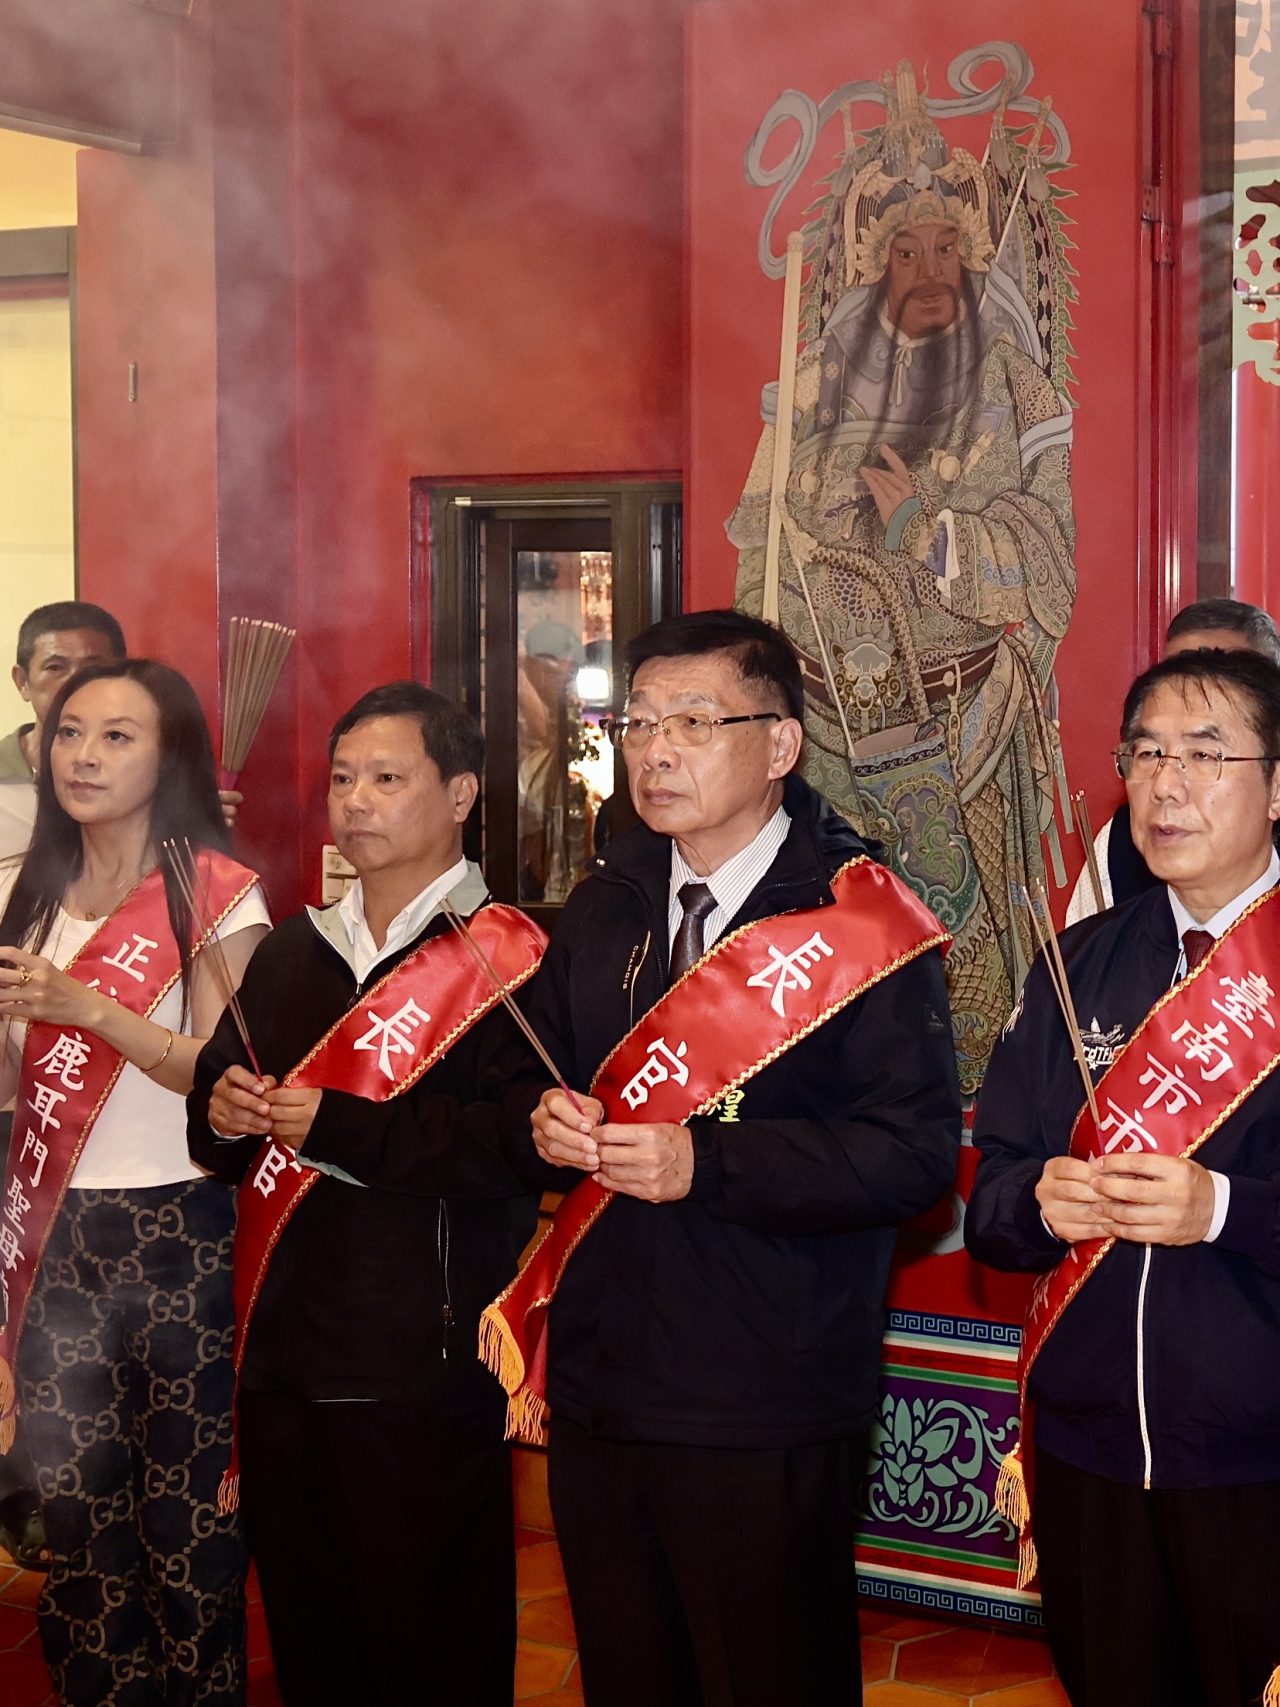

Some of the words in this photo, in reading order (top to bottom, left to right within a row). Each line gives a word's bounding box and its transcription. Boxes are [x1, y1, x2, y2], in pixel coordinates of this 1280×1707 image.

[620, 931, 835, 1112] 長官
[1086, 969, 1277, 1166] 臺南市市
[0, 933, 159, 1323] 正鹿耳門聖母
